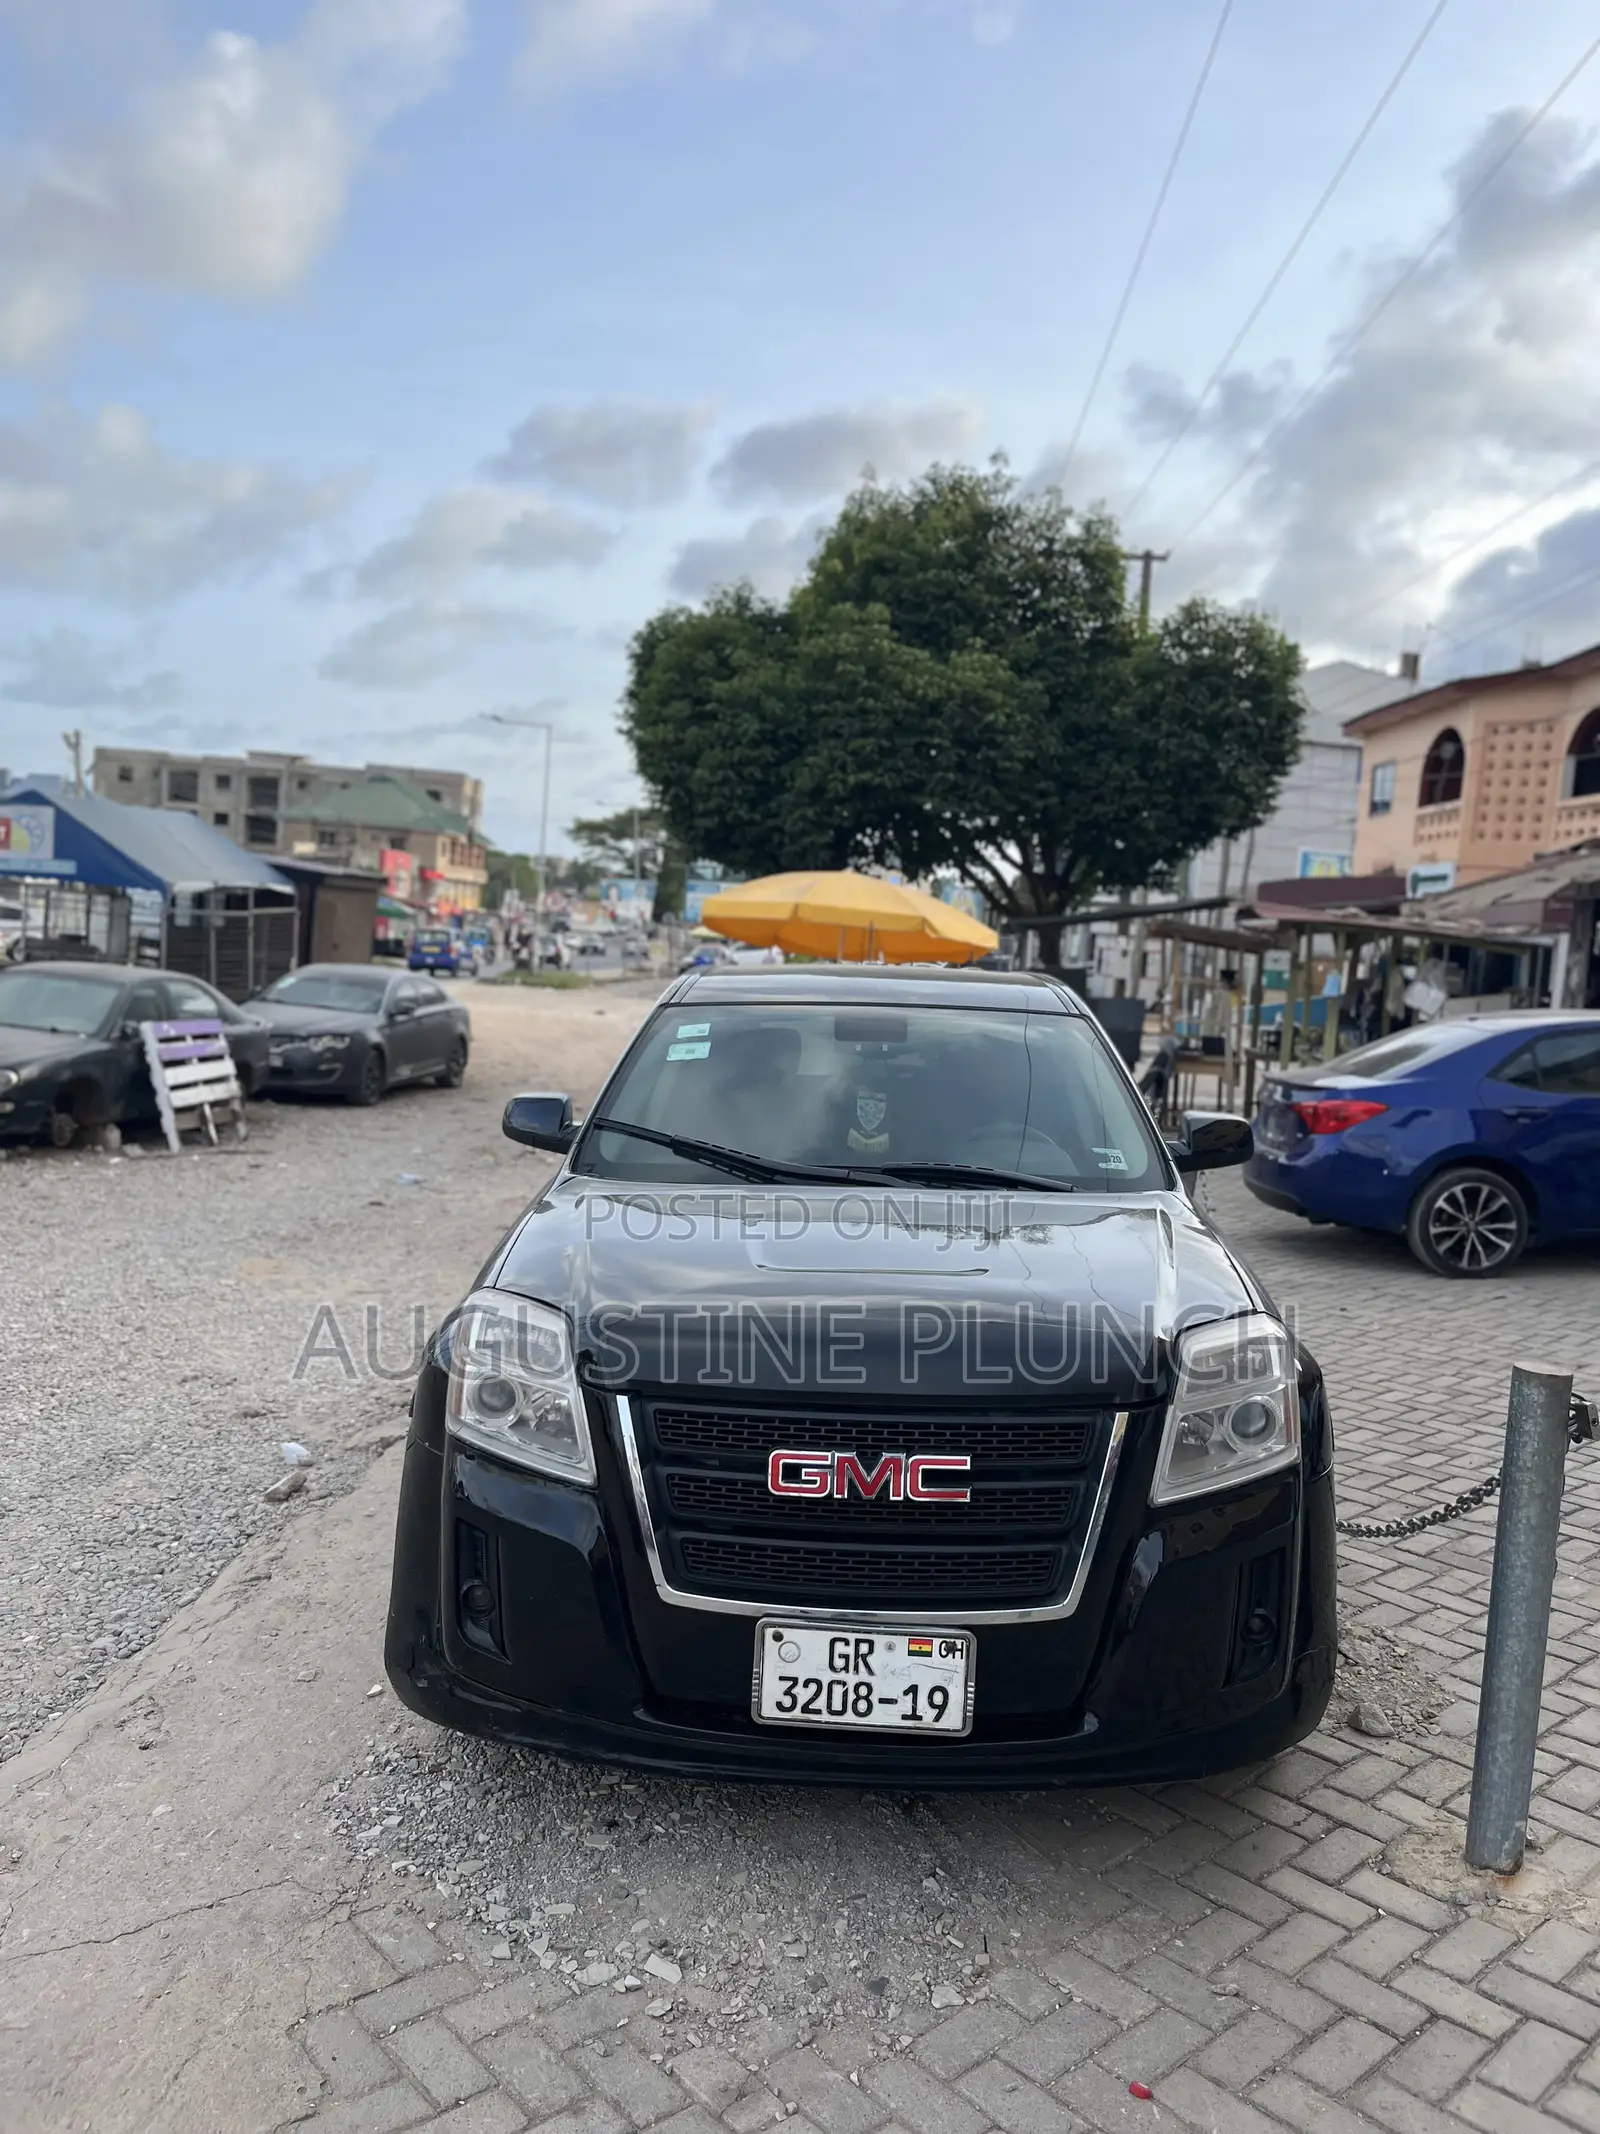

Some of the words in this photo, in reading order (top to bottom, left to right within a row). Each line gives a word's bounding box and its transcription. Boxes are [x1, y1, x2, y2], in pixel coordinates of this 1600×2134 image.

[768, 1449, 971, 1502] GMC
[828, 1636, 876, 1677] GR
[775, 1675, 950, 1723] 3208-19
